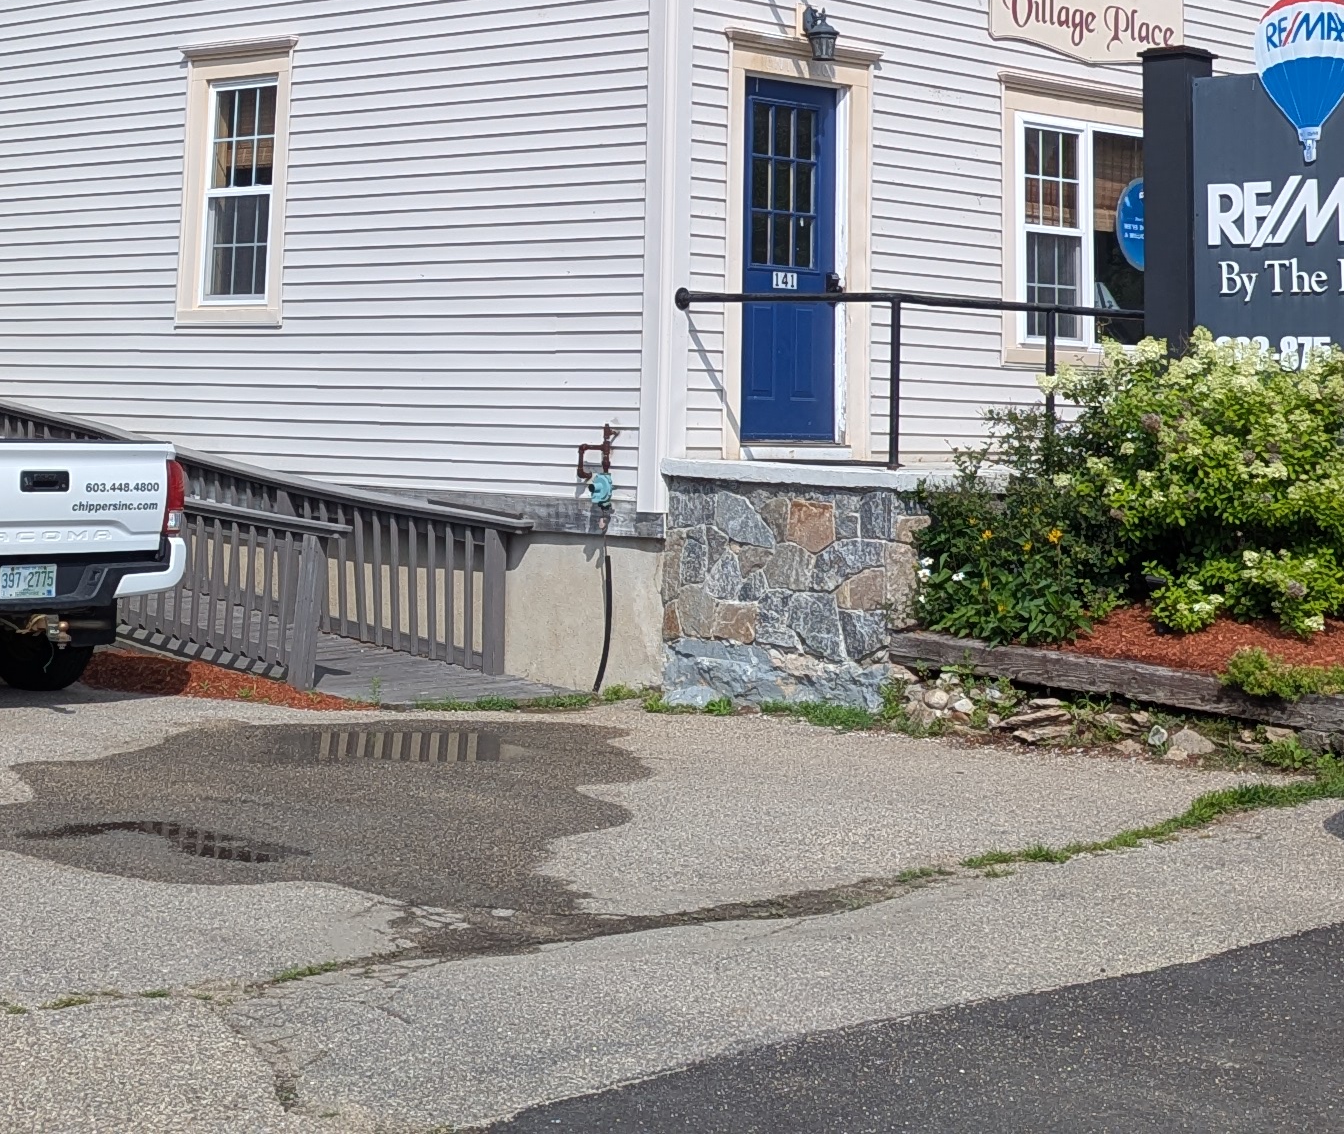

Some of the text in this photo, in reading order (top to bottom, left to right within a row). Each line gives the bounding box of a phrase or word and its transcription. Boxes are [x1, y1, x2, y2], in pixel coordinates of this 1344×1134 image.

[1103, 4, 1175, 53] Place
[774, 272, 796, 288] 141
[1218, 261, 1259, 302] By
[1264, 257, 1329, 293] The
[85, 482, 160, 493] 603.448.4800
[71, 500, 159, 513] chippersinc.com
[1, 570, 54, 589] 397 2775
